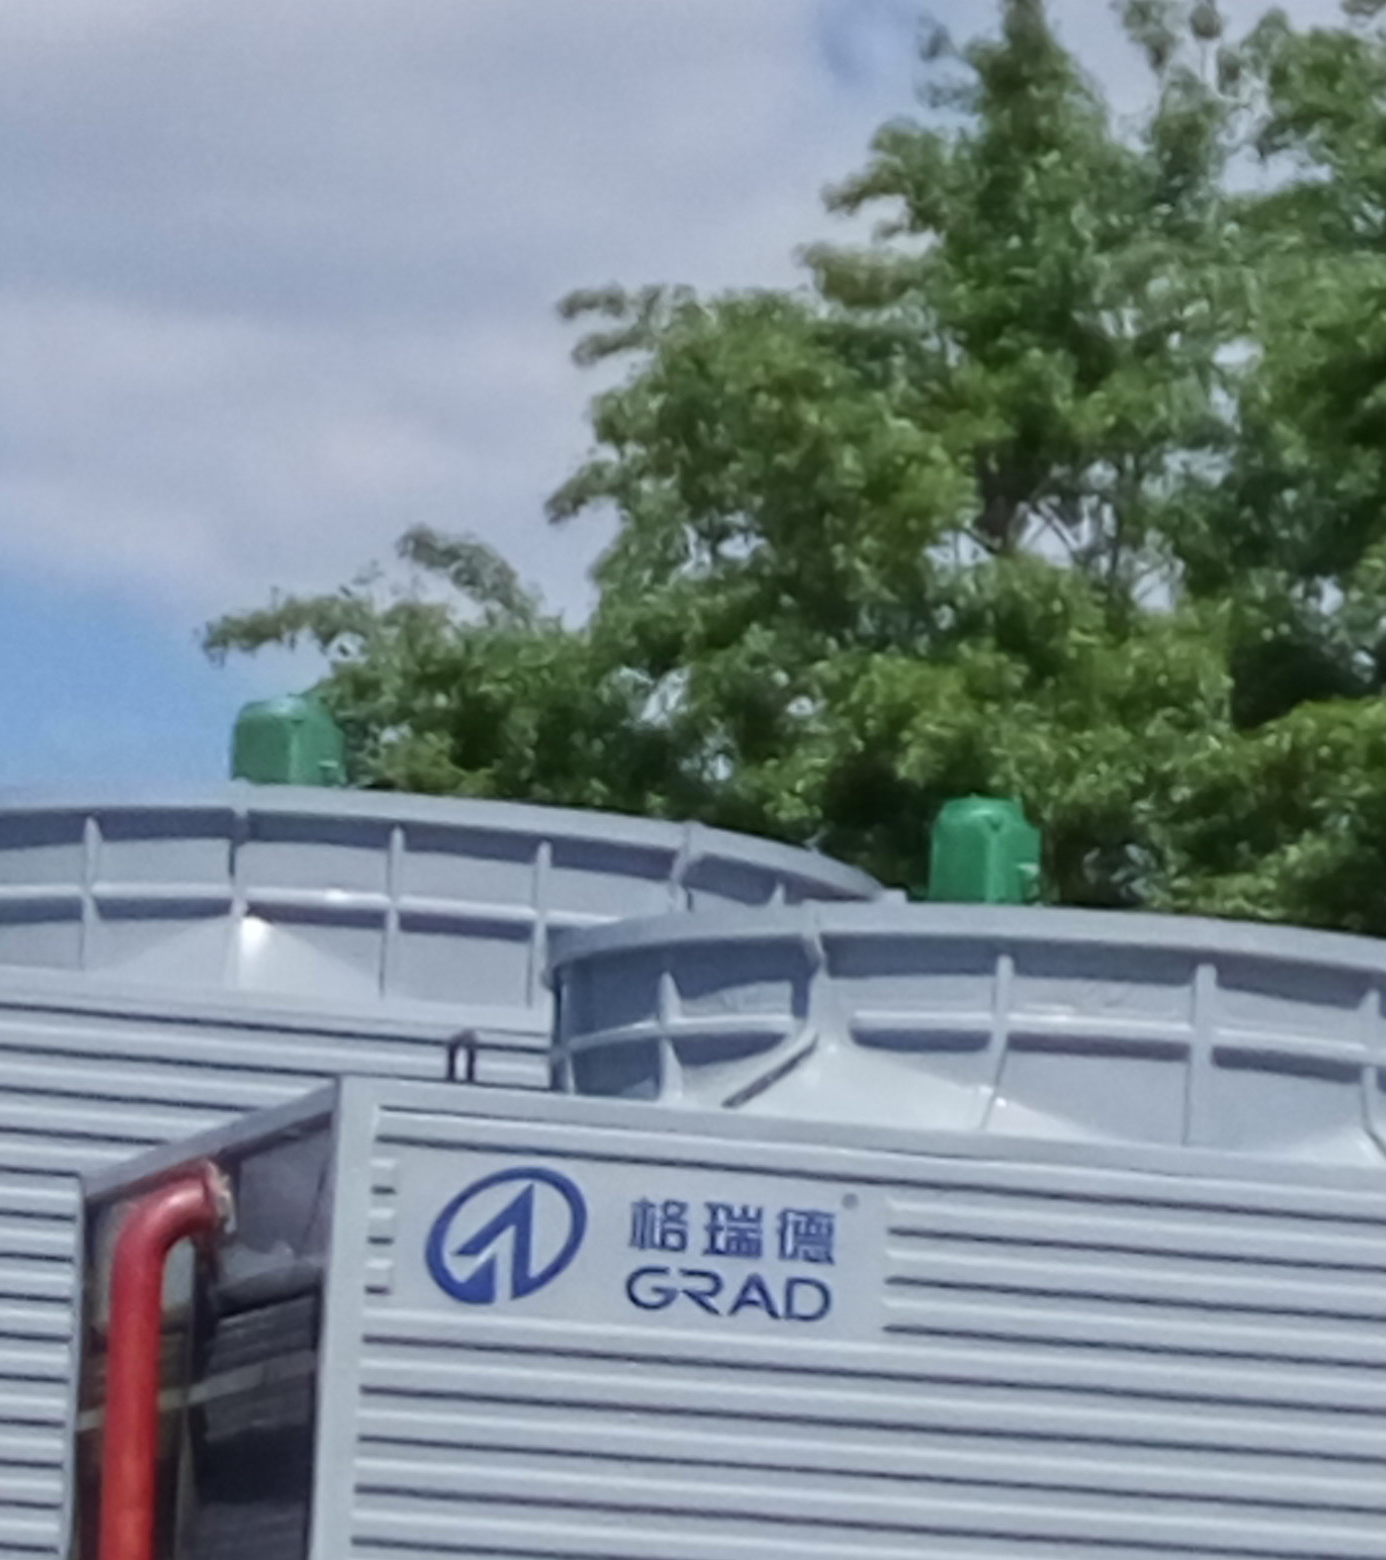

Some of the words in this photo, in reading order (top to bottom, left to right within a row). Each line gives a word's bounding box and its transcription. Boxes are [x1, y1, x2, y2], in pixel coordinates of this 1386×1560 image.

[629, 1197, 835, 1265] 格瑞德
[626, 1266, 831, 1323] GRAD
